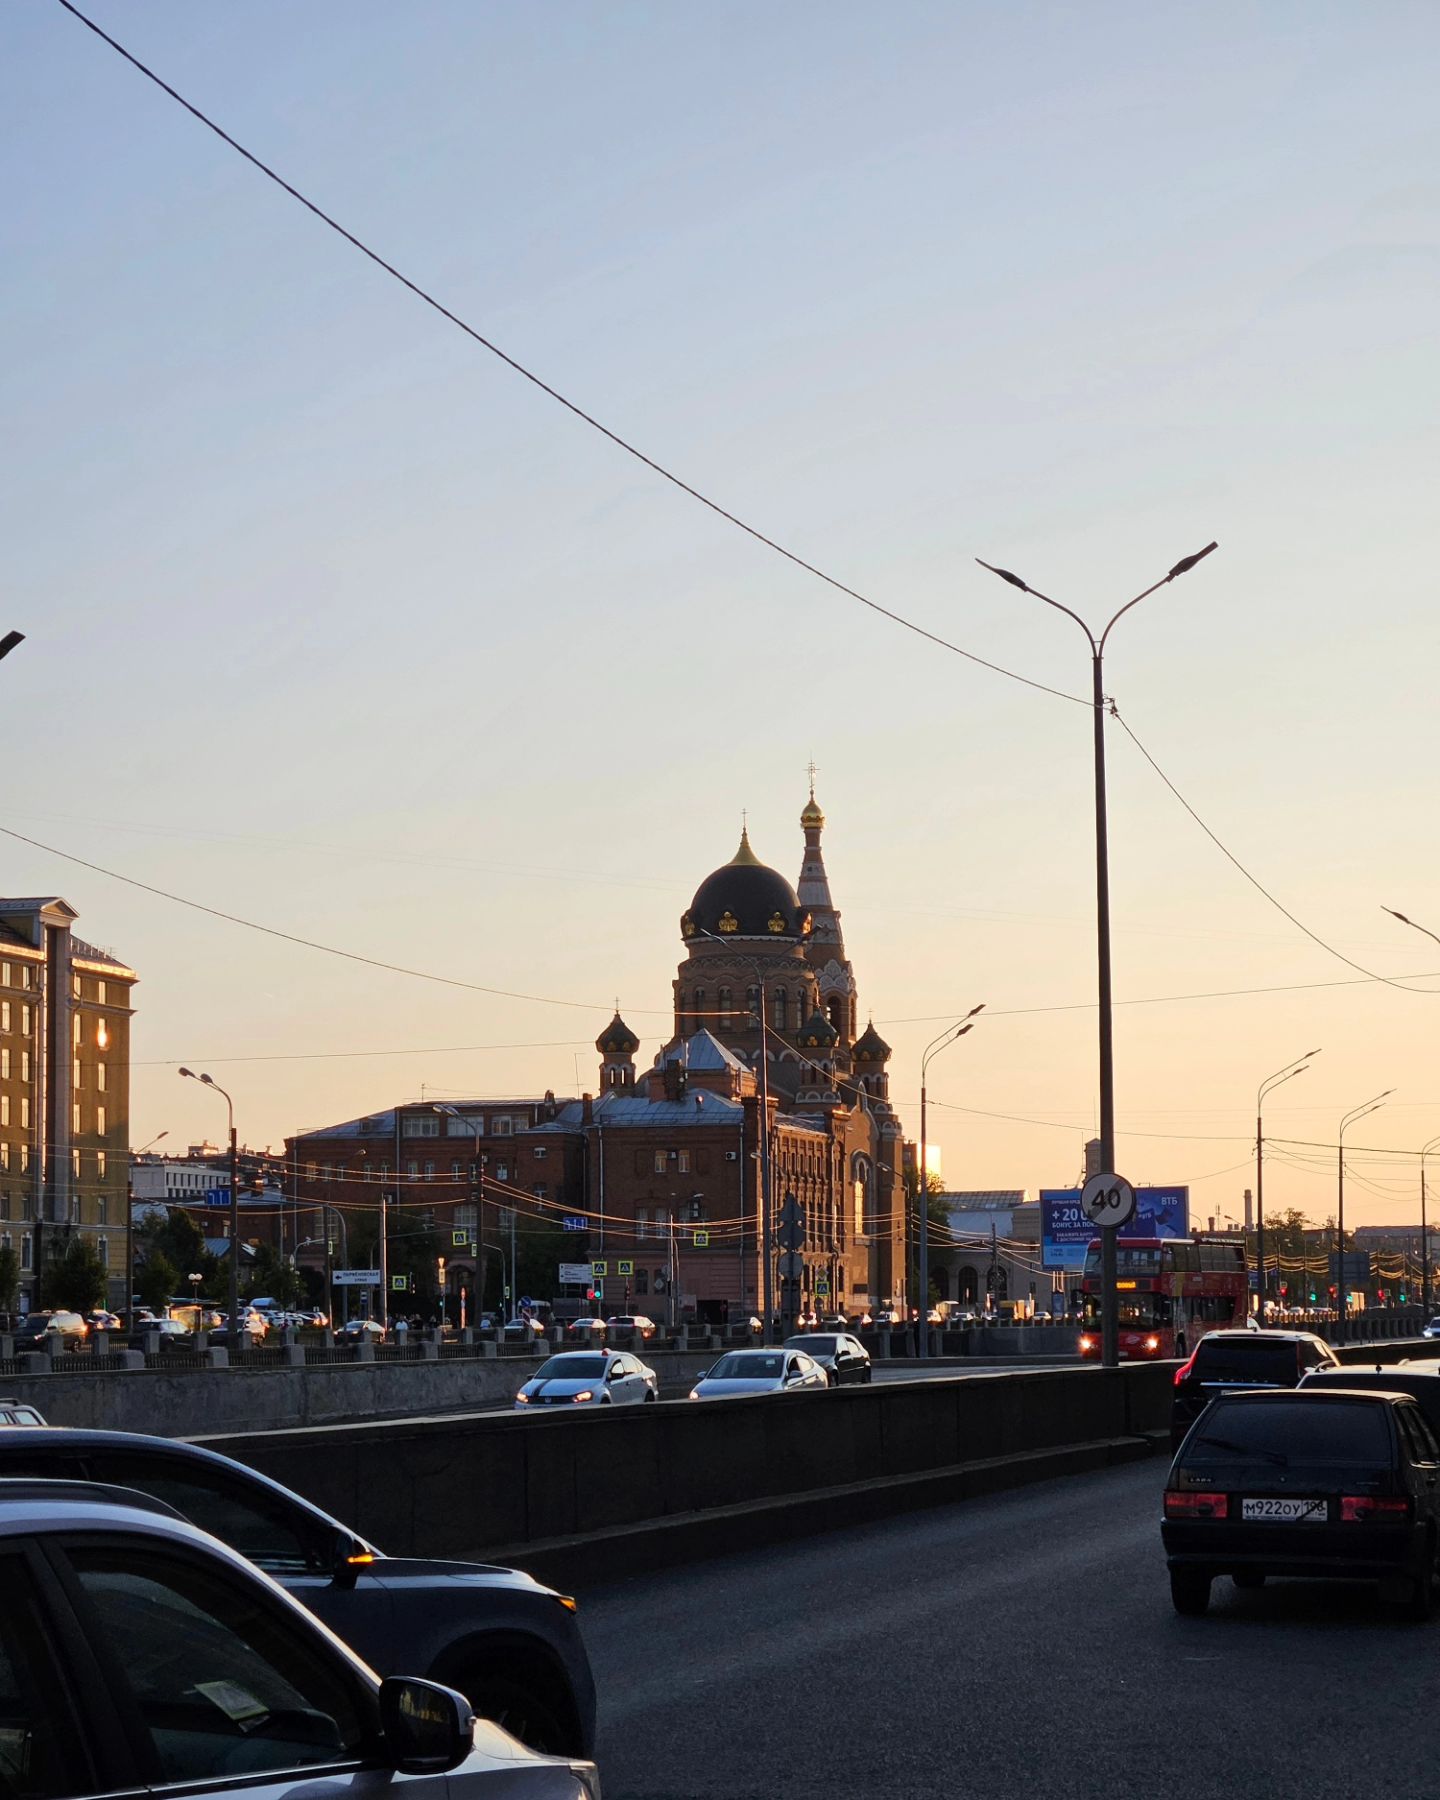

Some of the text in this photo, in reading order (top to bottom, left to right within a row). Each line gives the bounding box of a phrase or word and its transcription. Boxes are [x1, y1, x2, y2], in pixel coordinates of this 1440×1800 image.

[1091, 1188, 1120, 1209] 40
[1161, 1196, 1178, 1206] ВТБ
[1062, 1208, 1079, 1221] 20
